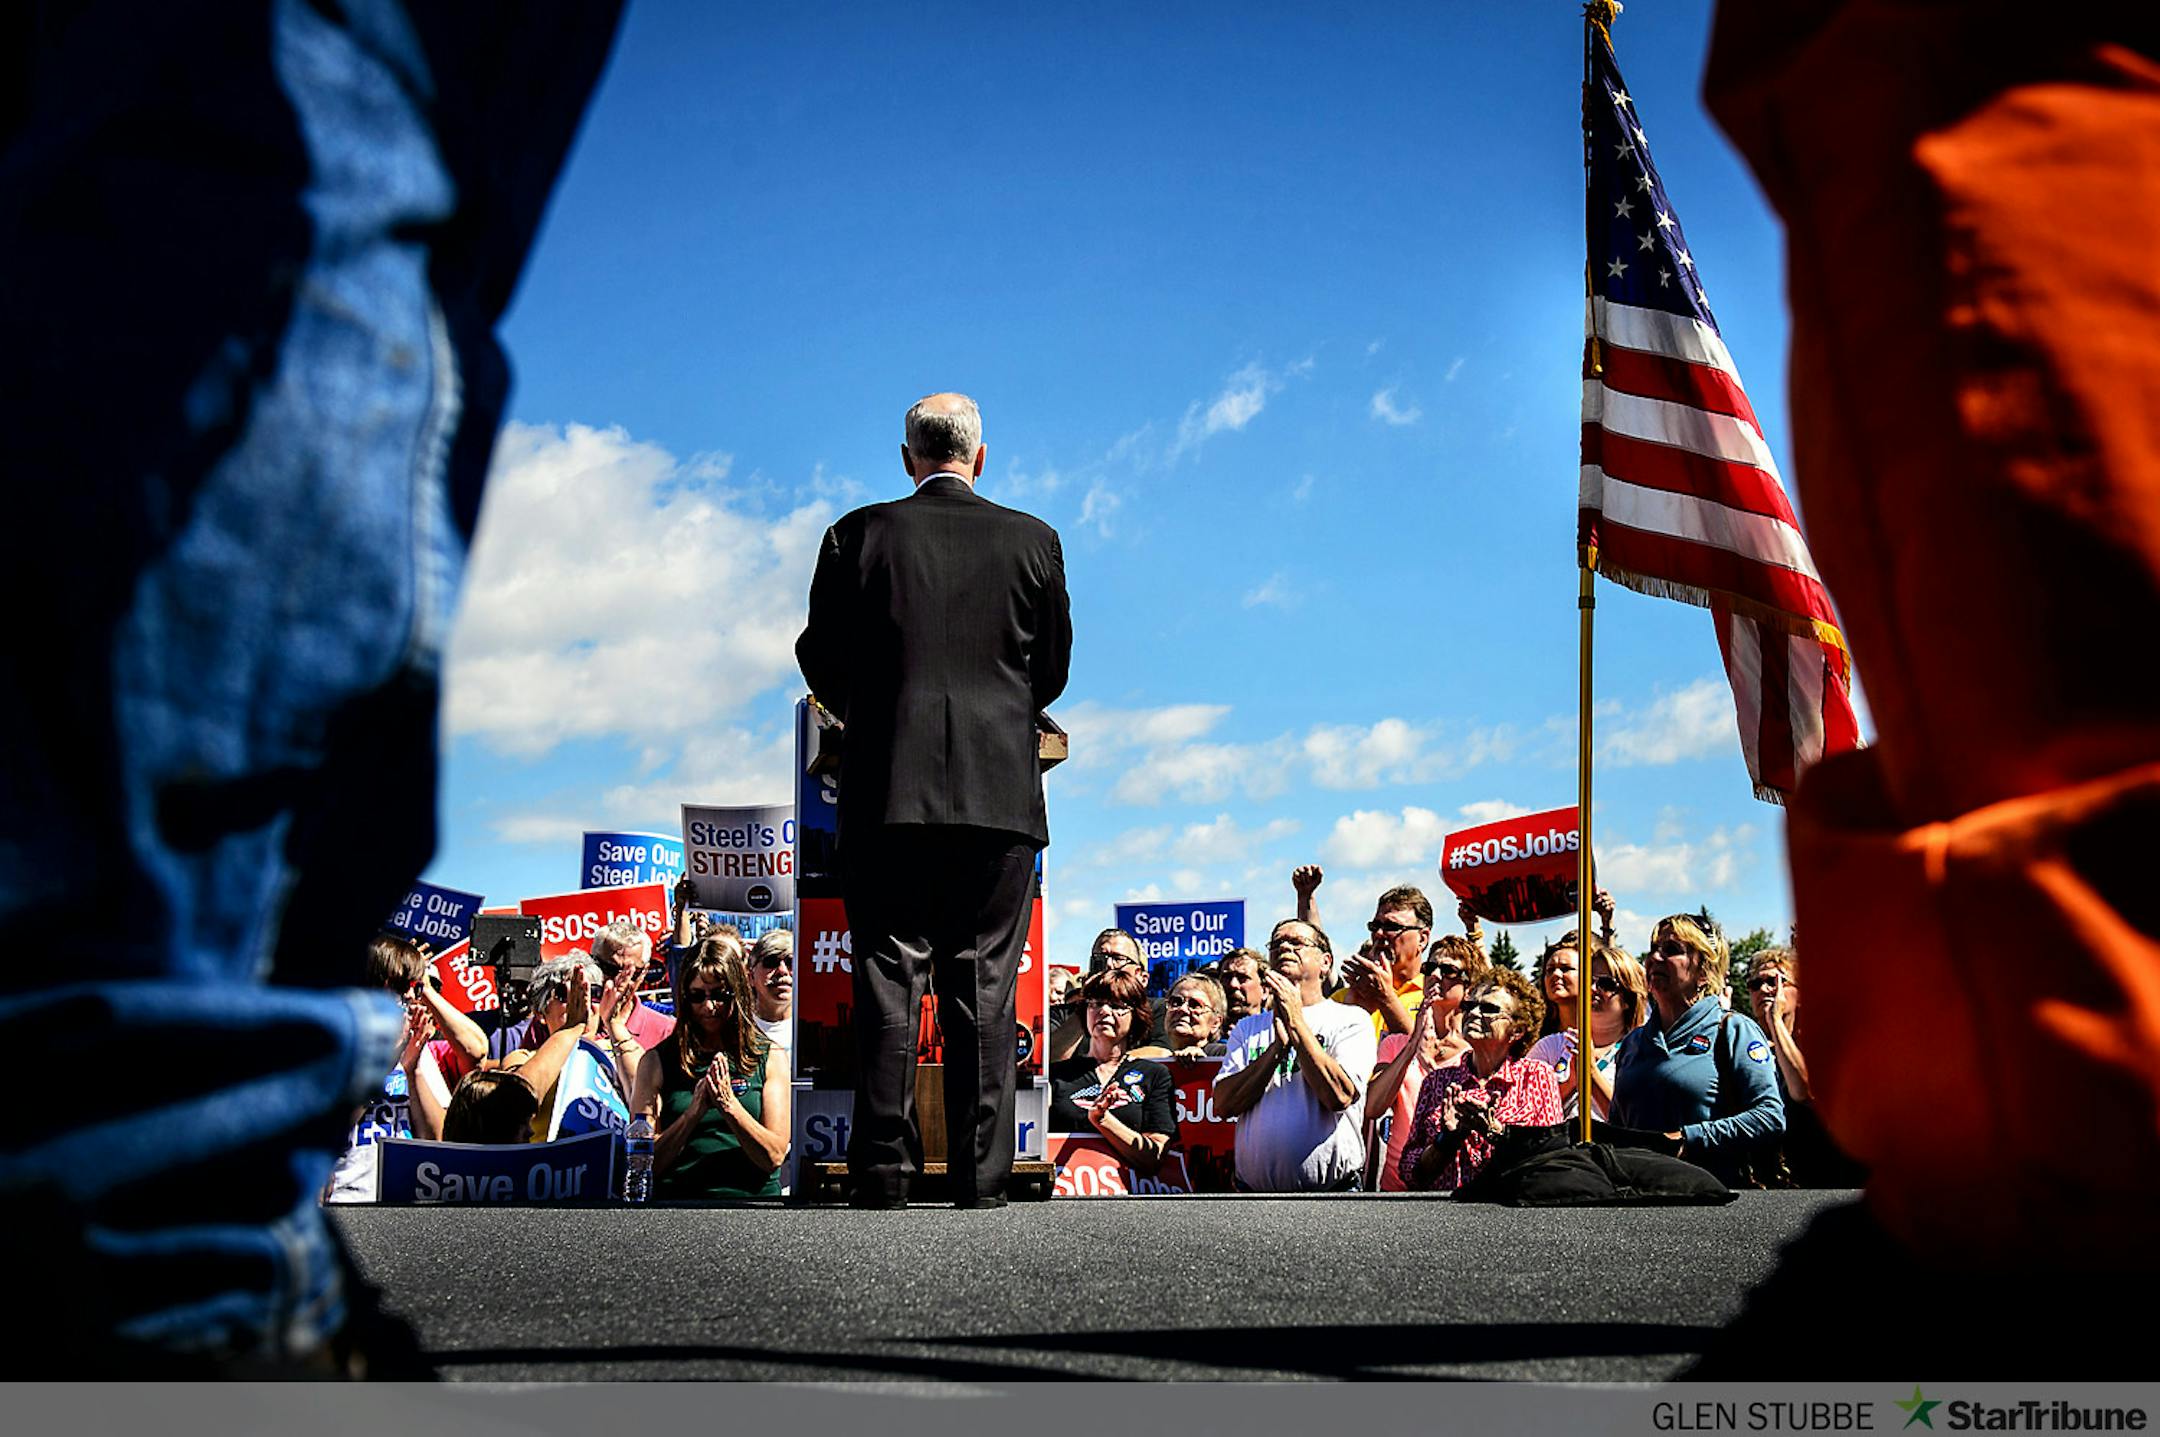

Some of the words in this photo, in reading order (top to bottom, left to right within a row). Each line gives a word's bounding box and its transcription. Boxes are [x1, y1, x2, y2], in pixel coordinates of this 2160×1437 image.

[690, 820, 775, 848] Steel's
[598, 841, 647, 863] Save
[652, 843, 681, 868] Our
[1449, 828, 1579, 869] #SOSJobs
[590, 864, 639, 885] Steel
[692, 849, 795, 878] STRENG
[426, 894, 463, 918] Our
[413, 914, 462, 940] Jobs
[1134, 913, 1185, 935] Save
[1190, 910, 1228, 932] Our
[1137, 936, 1180, 959] teel
[1184, 934, 1234, 957] Jobs
[415, 1161, 514, 1202] Save
[527, 1162, 587, 1201] Our
